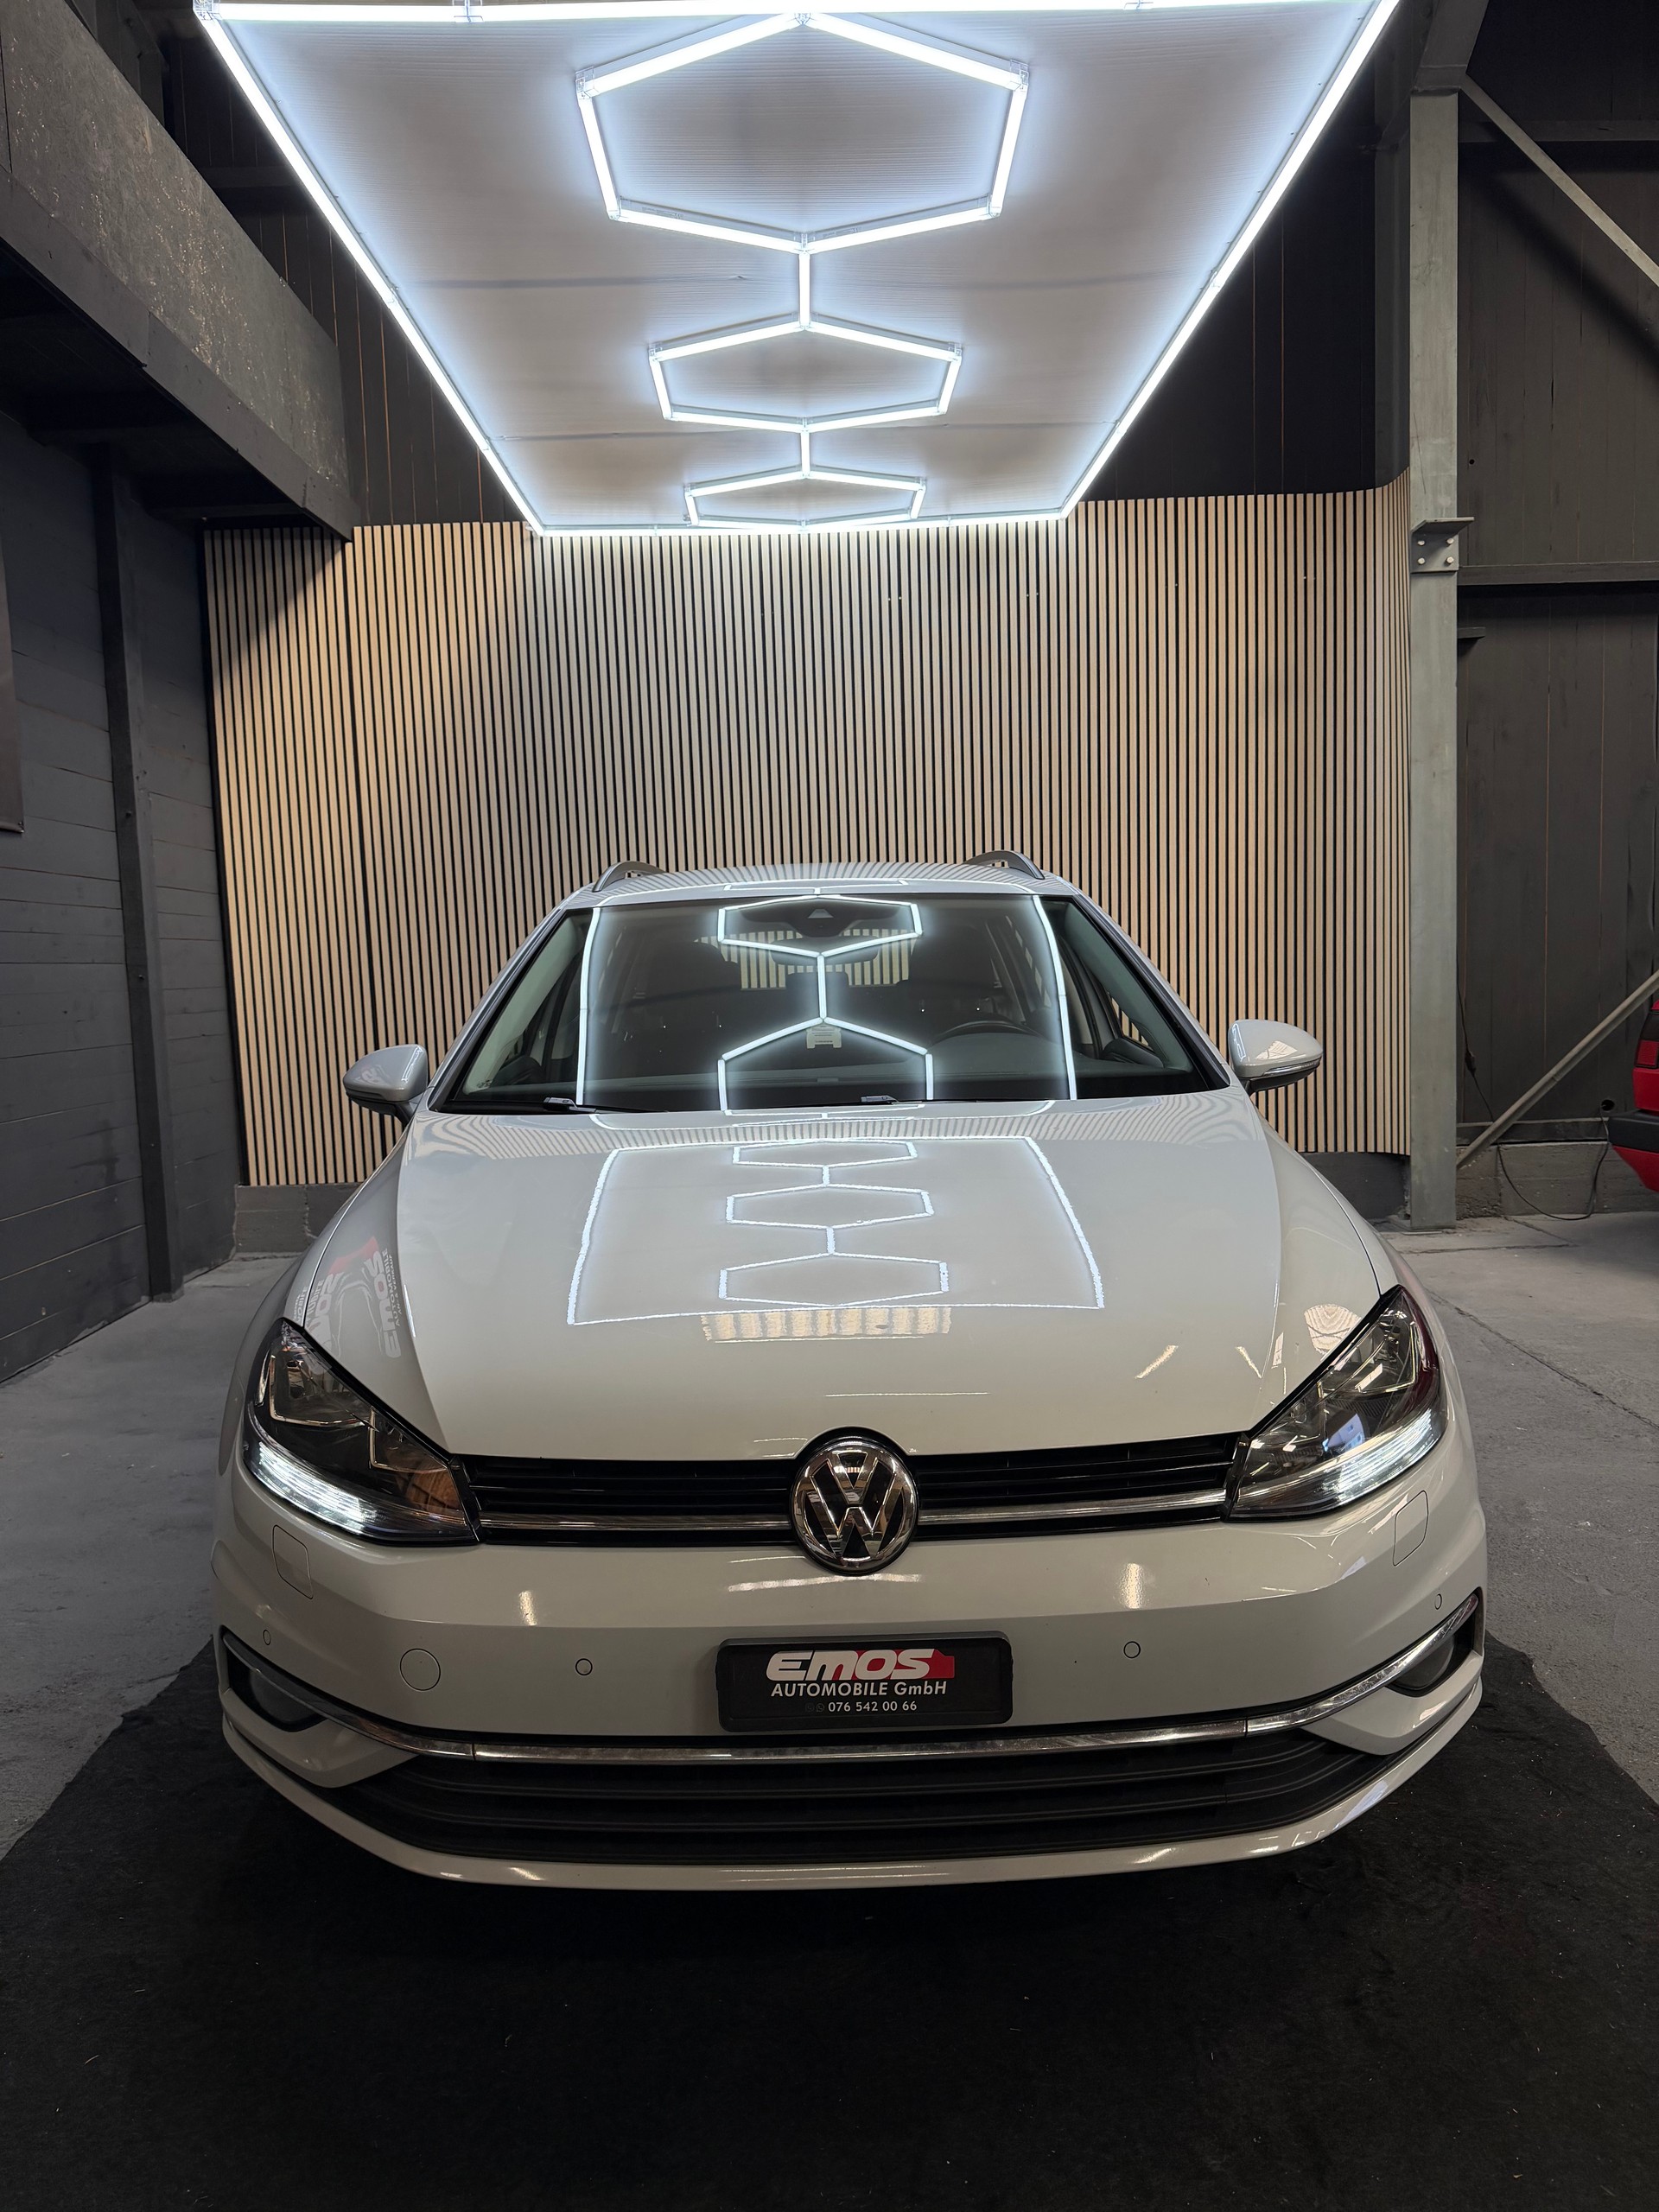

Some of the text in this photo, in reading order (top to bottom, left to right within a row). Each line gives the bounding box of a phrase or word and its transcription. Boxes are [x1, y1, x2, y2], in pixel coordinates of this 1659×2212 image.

[382, 1249, 400, 1326] AUTOMOBILE
[364, 1250, 401, 1358] EMOS
[766, 1649, 935, 1681] EMOS
[771, 1681, 947, 1697] AUTOMOBILE GmbH
[828, 1700, 918, 1713] 076 542 00 66
